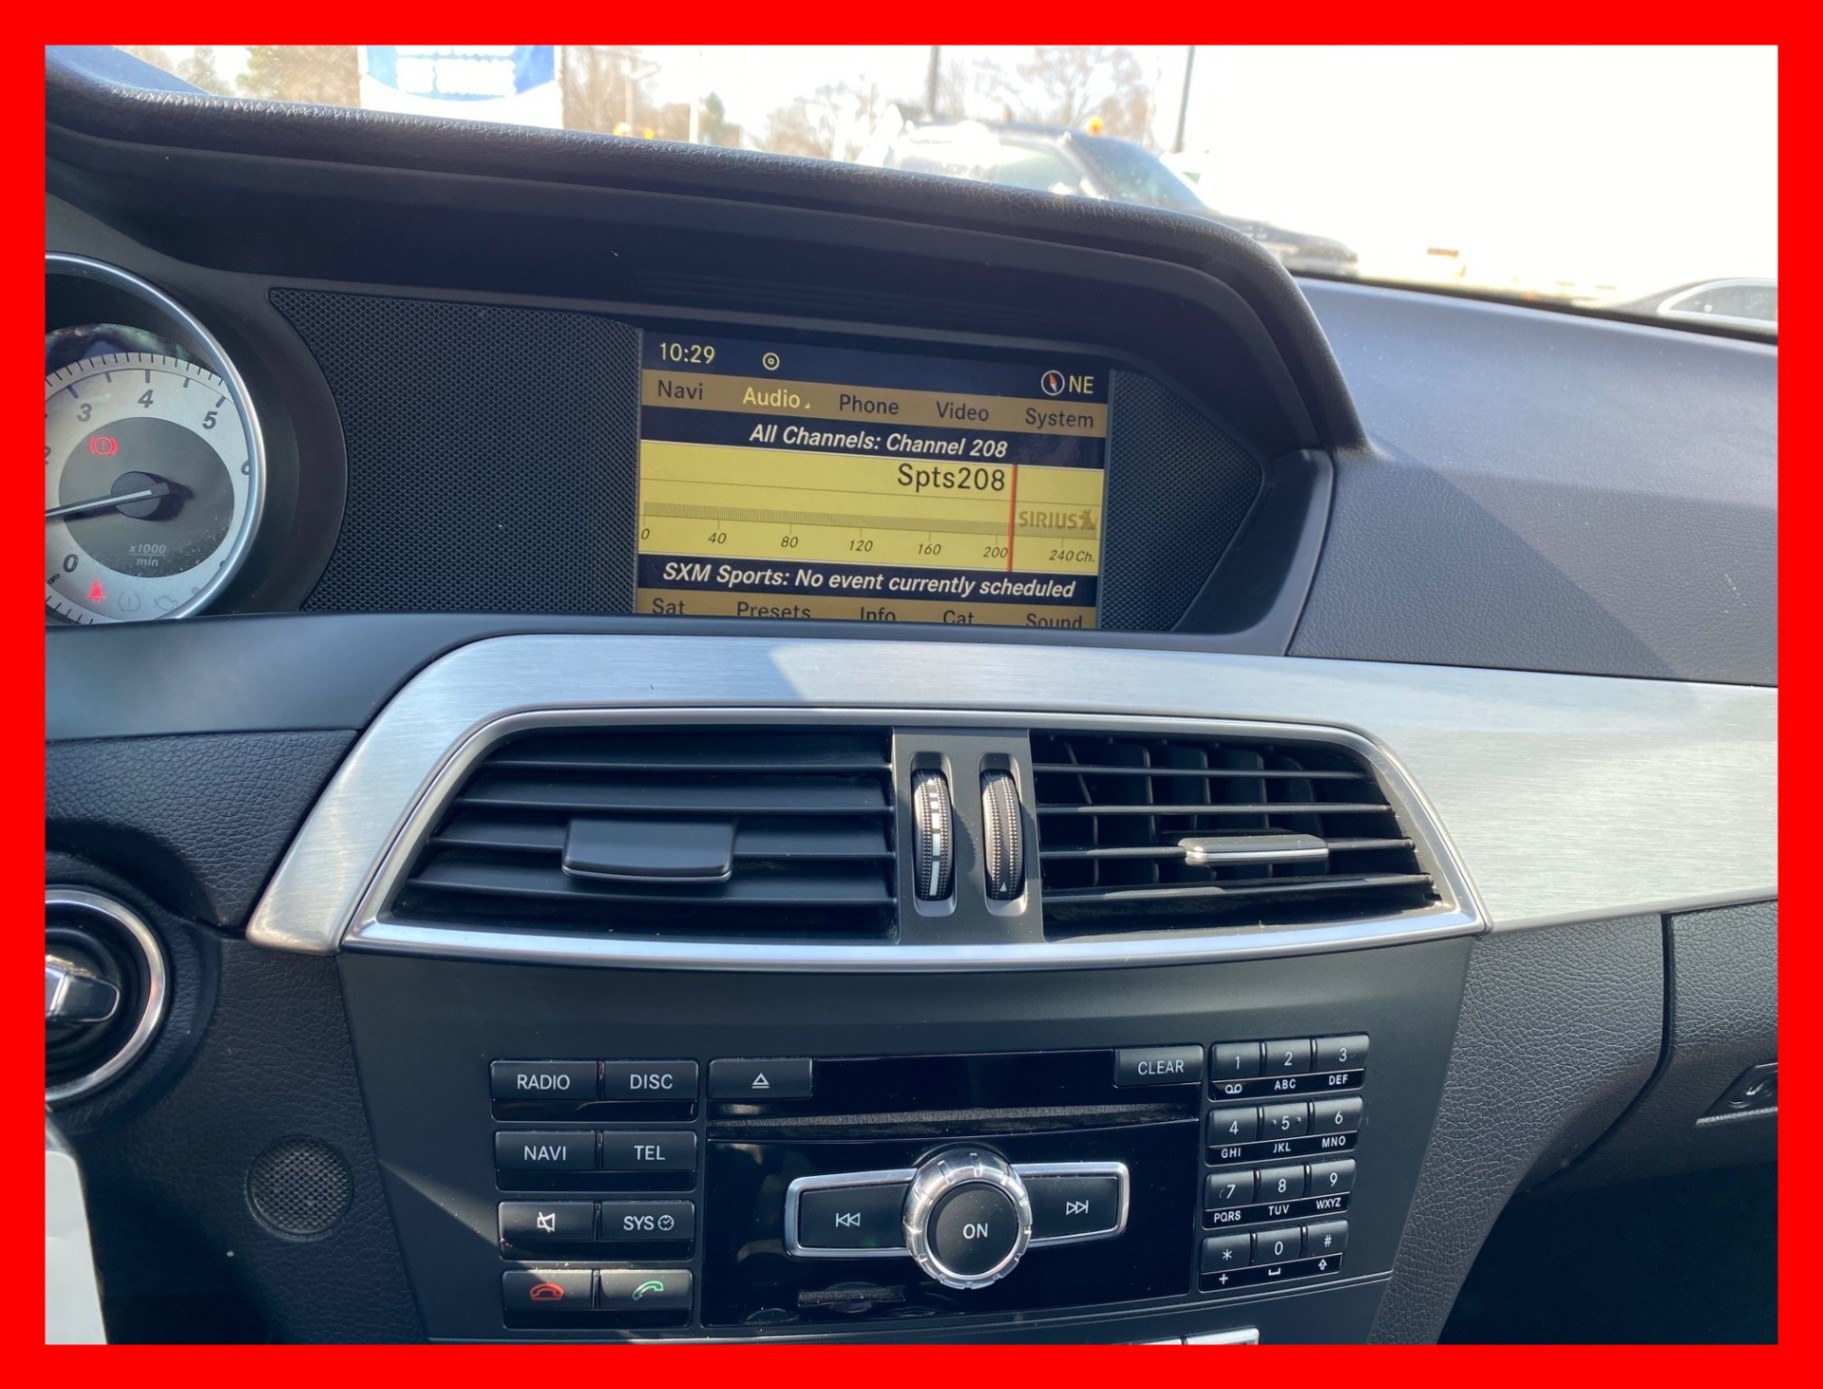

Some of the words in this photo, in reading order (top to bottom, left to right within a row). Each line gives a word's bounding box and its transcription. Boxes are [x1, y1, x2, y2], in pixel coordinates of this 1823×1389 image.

[660, 342, 715, 364] 10:29
[1069, 375, 1094, 394] NE
[138, 389, 154, 408] 4
[658, 379, 703, 400] Navi
[742, 387, 801, 409] Audio
[840, 394, 899, 415] Phone
[936, 401, 989, 421] Video
[1025, 407, 1094, 430] System
[77, 403, 92, 422] 3
[202, 411, 218, 430] 5
[749, 424, 778, 443] All
[783, 425, 881, 450] Channels:
[886, 433, 966, 455] Channel
[970, 440, 1008, 457] 208
[898, 463, 1005, 493] Spts208
[641, 528, 650, 540] 0
[708, 532, 727, 544] 40
[780, 536, 799, 548] 80
[849, 540, 873, 552] 120
[918, 544, 941, 555] 160
[983, 547, 1008, 559] 200
[1049, 549, 1074, 562] 240
[63, 554, 78, 572] 0
[136, 556, 159, 567] min
[663, 562, 711, 582] SXM
[716, 565, 790, 587] Sports:
[795, 569, 823, 587] No
[828, 574, 883, 590] event
[889, 576, 975, 598] currently
[979, 578, 1076, 598] scheduled
[652, 598, 685, 615] Sat
[737, 601, 811, 619] Presets
[860, 606, 896, 621] Info
[943, 610, 974, 625] Cat
[1026, 613, 1083, 629] Sound
[1284, 1052, 1293, 1066] 2
[1338, 1047, 1348, 1062] 3
[1137, 1060, 1184, 1076] CLEAR
[1235, 1056, 1241, 1070] 1
[516, 1074, 571, 1090] RADIO
[630, 1074, 673, 1090] DISC
[1274, 1079, 1297, 1091] ABC
[1328, 1074, 1349, 1086] DEF
[1281, 1116, 1290, 1130] 5
[1335, 1111, 1343, 1125] 6
[1229, 1120, 1239, 1135] 4
[1273, 1143, 1291, 1153] JKL
[1321, 1136, 1346, 1148] MNO
[523, 1145, 567, 1161] NAVI
[634, 1145, 666, 1161] TEL
[1221, 1148, 1242, 1158] GHI
[1278, 1179, 1287, 1193] 8
[1329, 1173, 1338, 1187] 9
[1226, 1184, 1236, 1198] 7
[1268, 1204, 1290, 1216] TUV
[1316, 1198, 1342, 1210] WXYZ
[623, 1215, 655, 1230] SYS
[1213, 1210, 1242, 1223] PQRS
[963, 1222, 988, 1240] ON
[1274, 1241, 1284, 1255] 0
